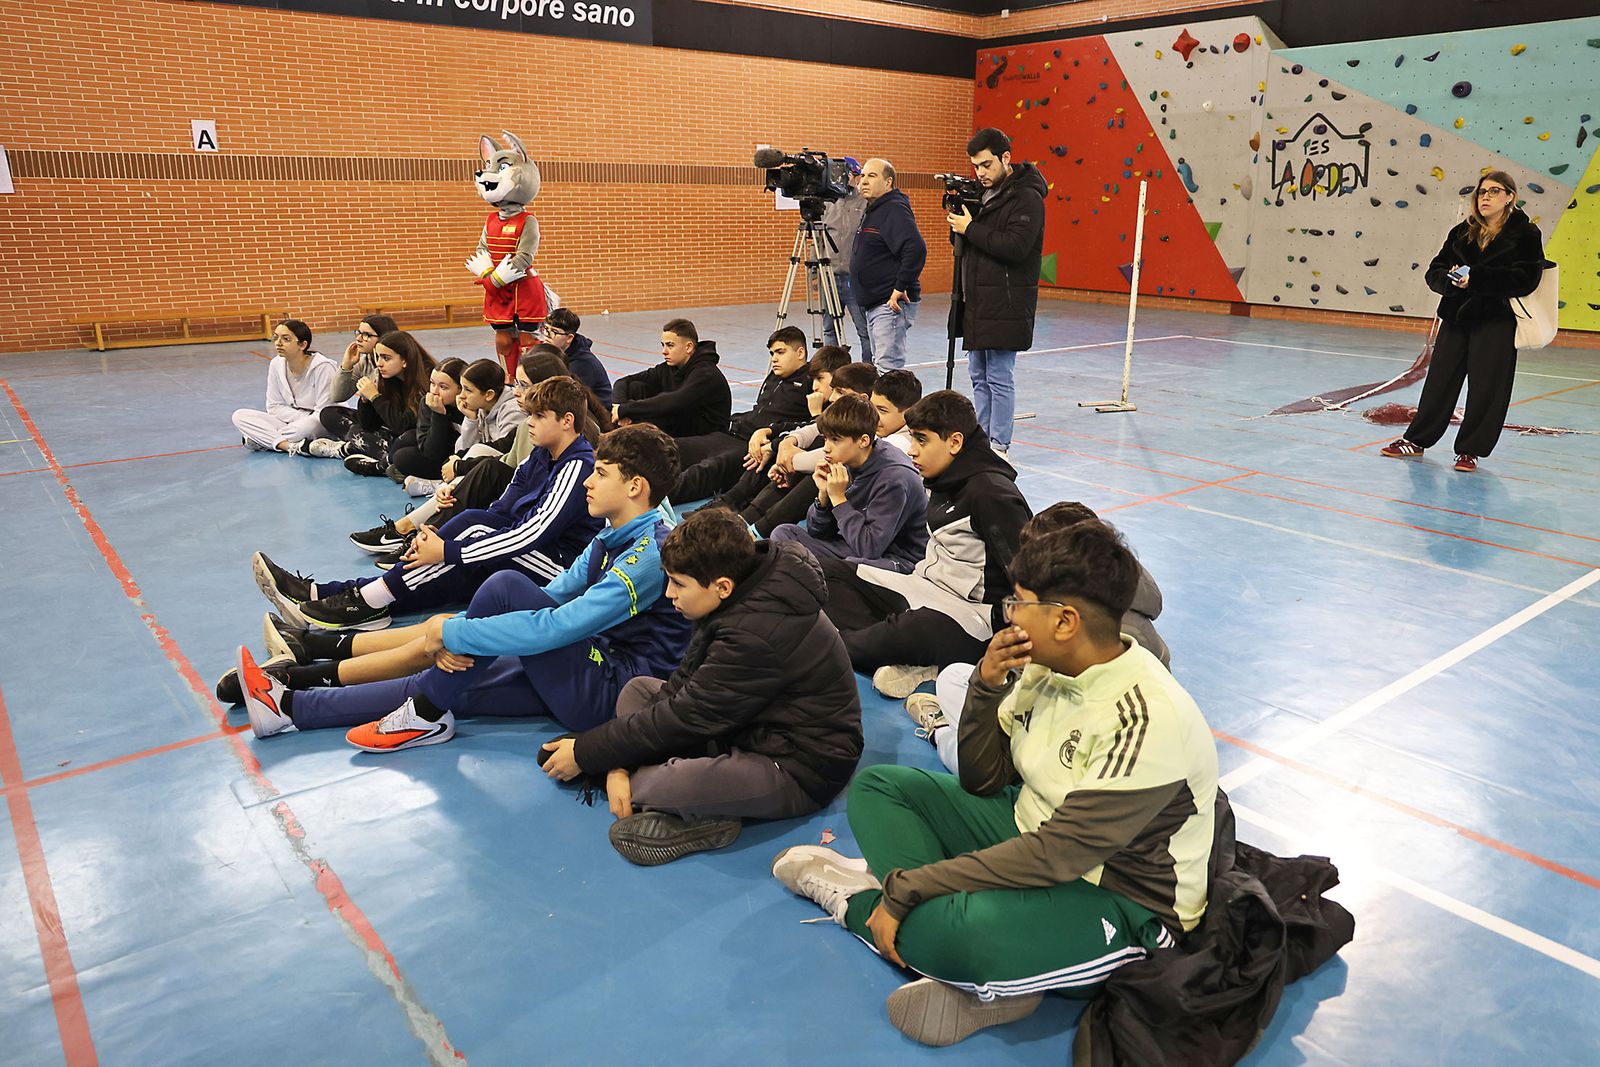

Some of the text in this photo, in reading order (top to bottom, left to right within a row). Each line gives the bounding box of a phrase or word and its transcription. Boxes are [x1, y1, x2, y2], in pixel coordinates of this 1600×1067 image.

[455, 0, 635, 27] corpore sano
[197, 129, 216, 150] A
[1300, 158, 1369, 201] ORDEN
